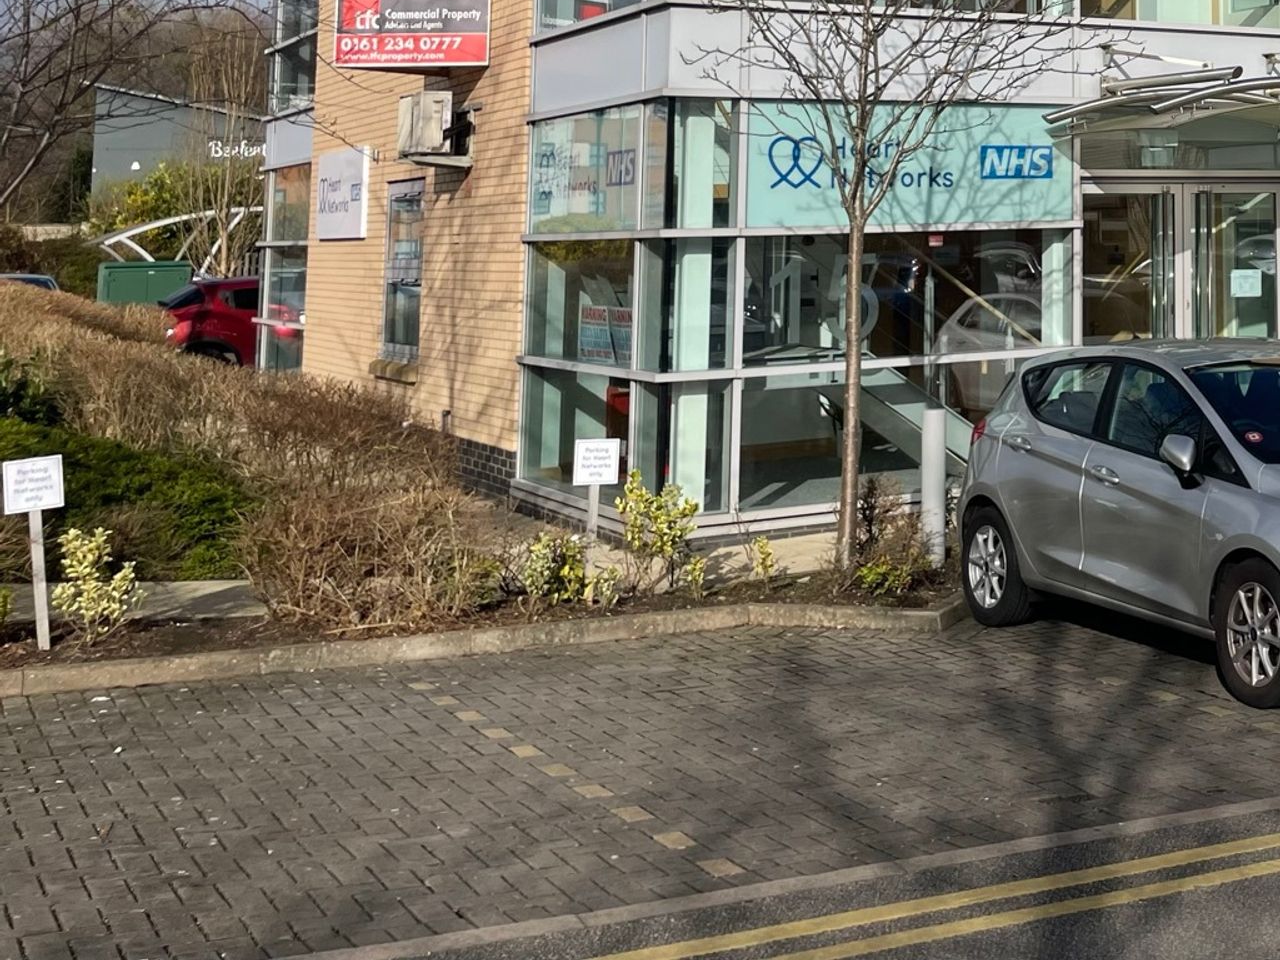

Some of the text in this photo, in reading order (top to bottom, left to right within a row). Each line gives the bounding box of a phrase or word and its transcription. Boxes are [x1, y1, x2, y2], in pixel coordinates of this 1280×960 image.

[385, 8, 481, 21] Commercial Property
[422, 21, 444, 30] Agents
[341, 37, 463, 51] 0161 234 0777
[607, 150, 635, 185] NHS
[982, 147, 1051, 178] NHS
[831, 166, 954, 188] Ntorks
